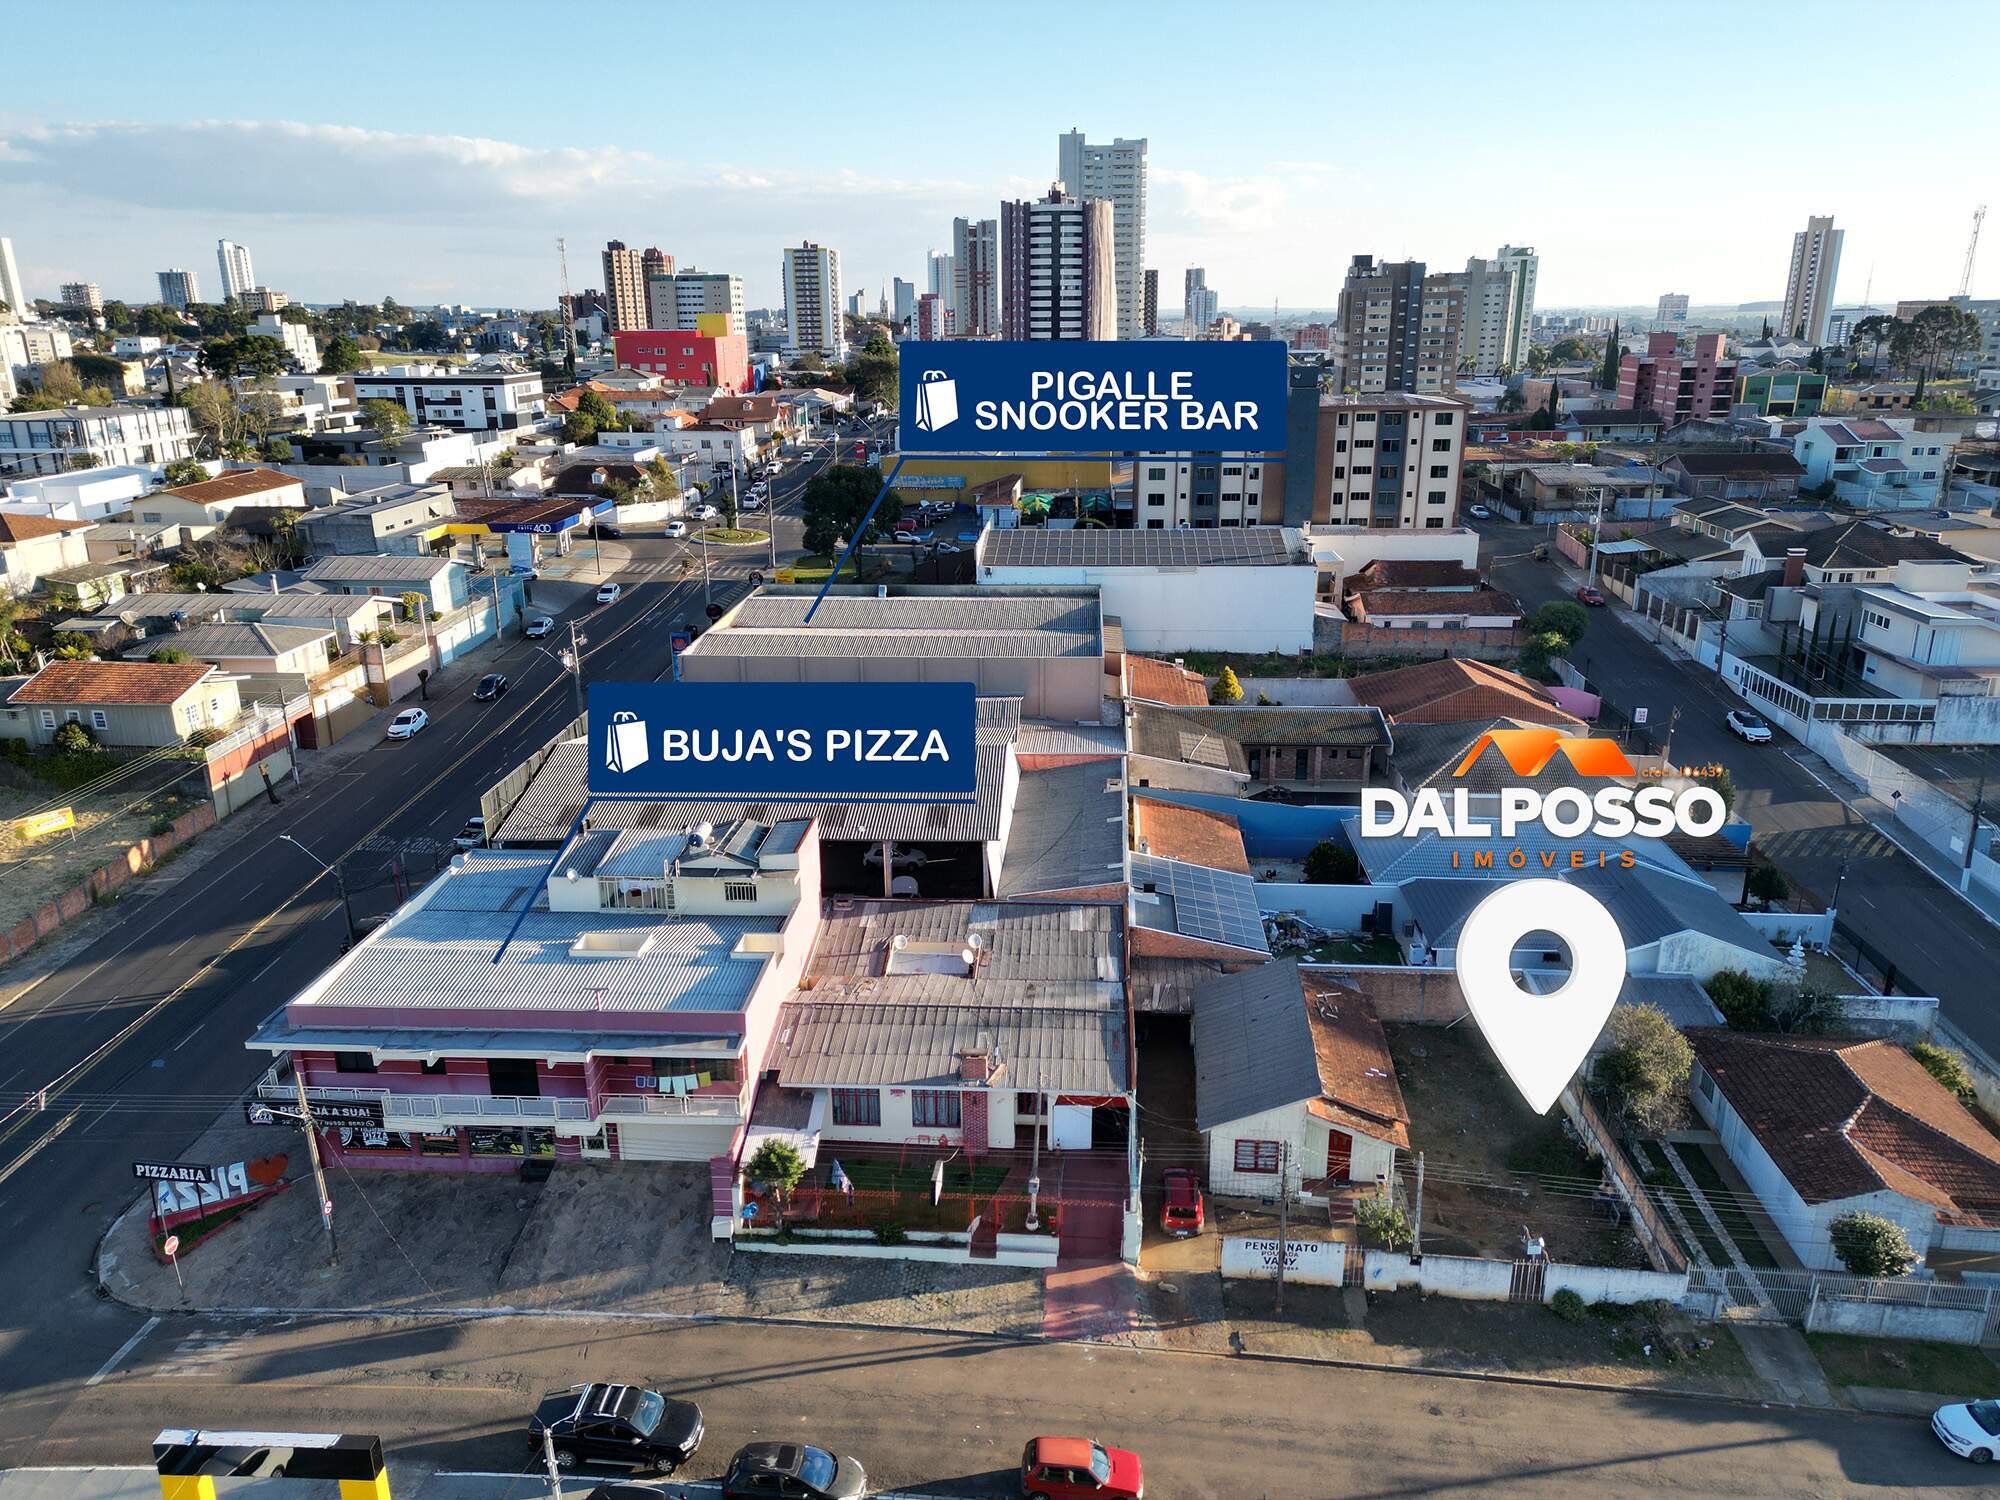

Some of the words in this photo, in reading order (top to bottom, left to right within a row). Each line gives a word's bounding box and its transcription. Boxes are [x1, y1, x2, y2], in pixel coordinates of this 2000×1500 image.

[332, 1107, 340, 1116] A
[342, 1107, 370, 1117] SUA!
[136, 1164, 206, 1181] PIZZARIA
[1245, 1241, 1318, 1253] PENSINATO
